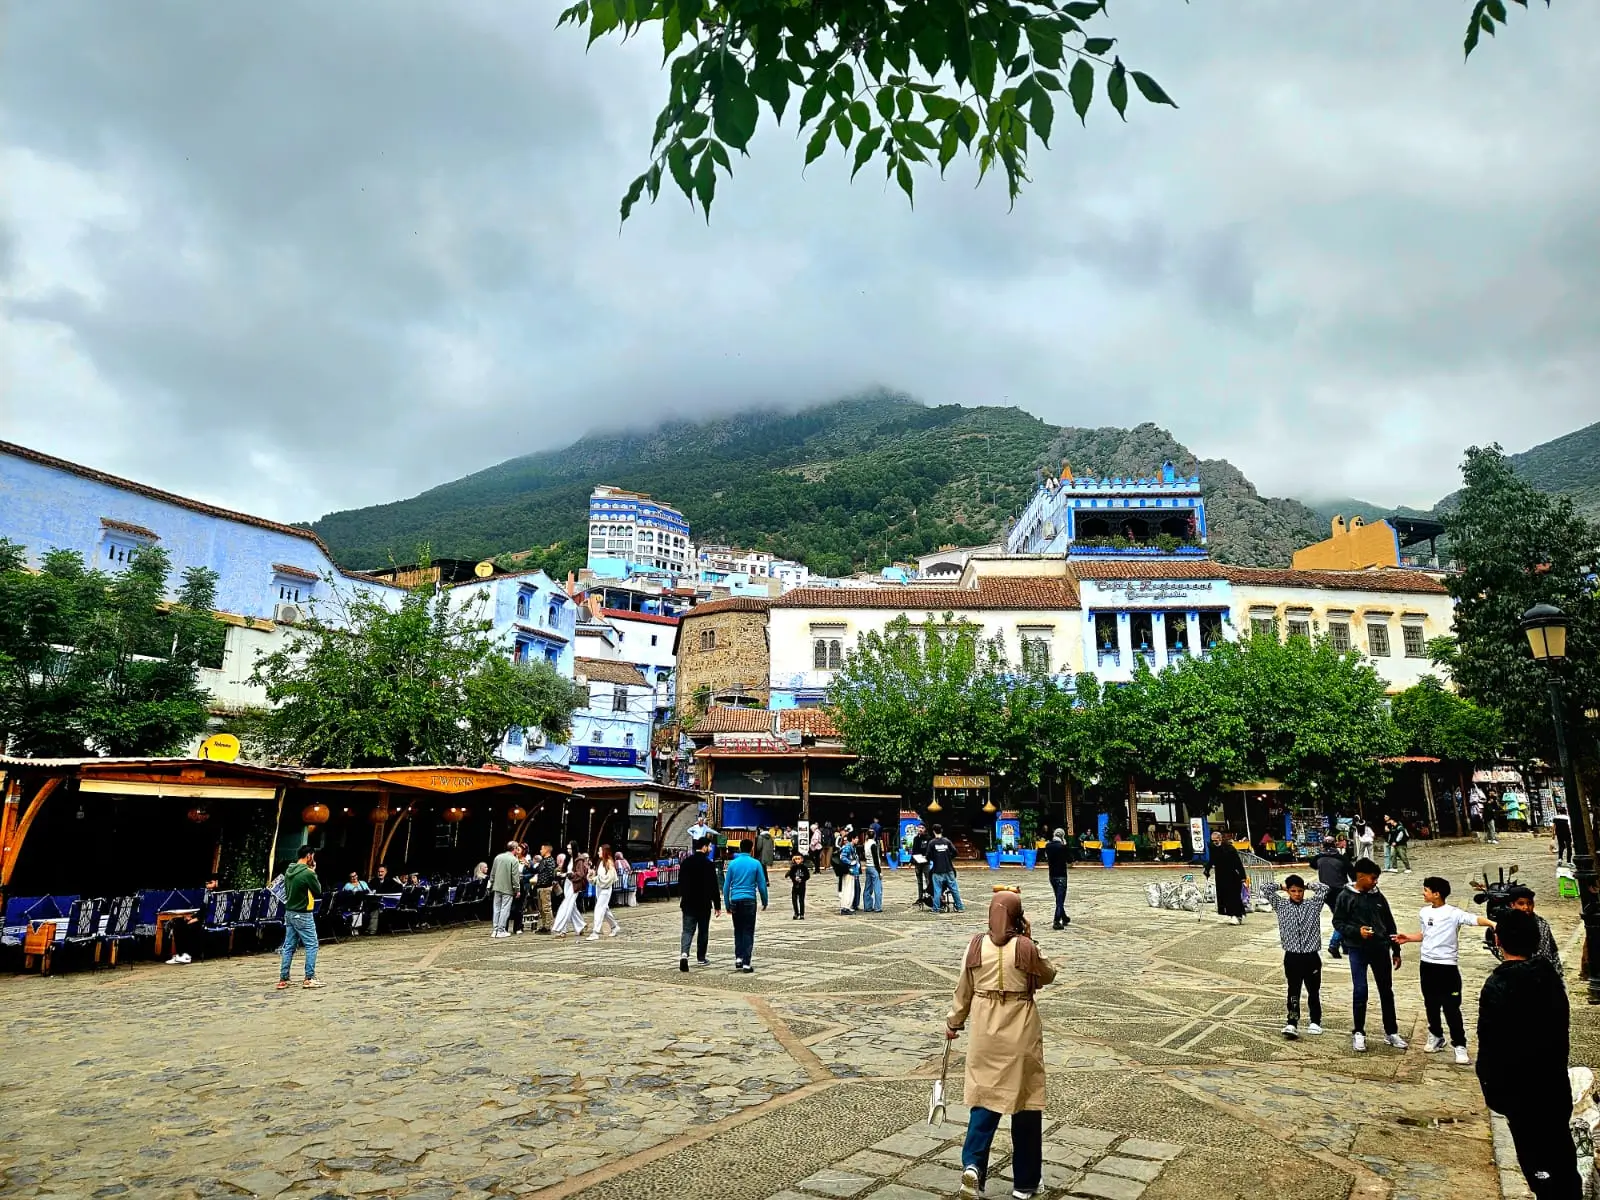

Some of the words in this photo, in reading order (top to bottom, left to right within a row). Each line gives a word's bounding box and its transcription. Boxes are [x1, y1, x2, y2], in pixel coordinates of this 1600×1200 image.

[1138, 580, 1212, 592] Restaurant
[719, 737, 791, 753] TWINS
[430, 775, 474, 787] TWINS
[939, 777, 985, 786] TWINS
